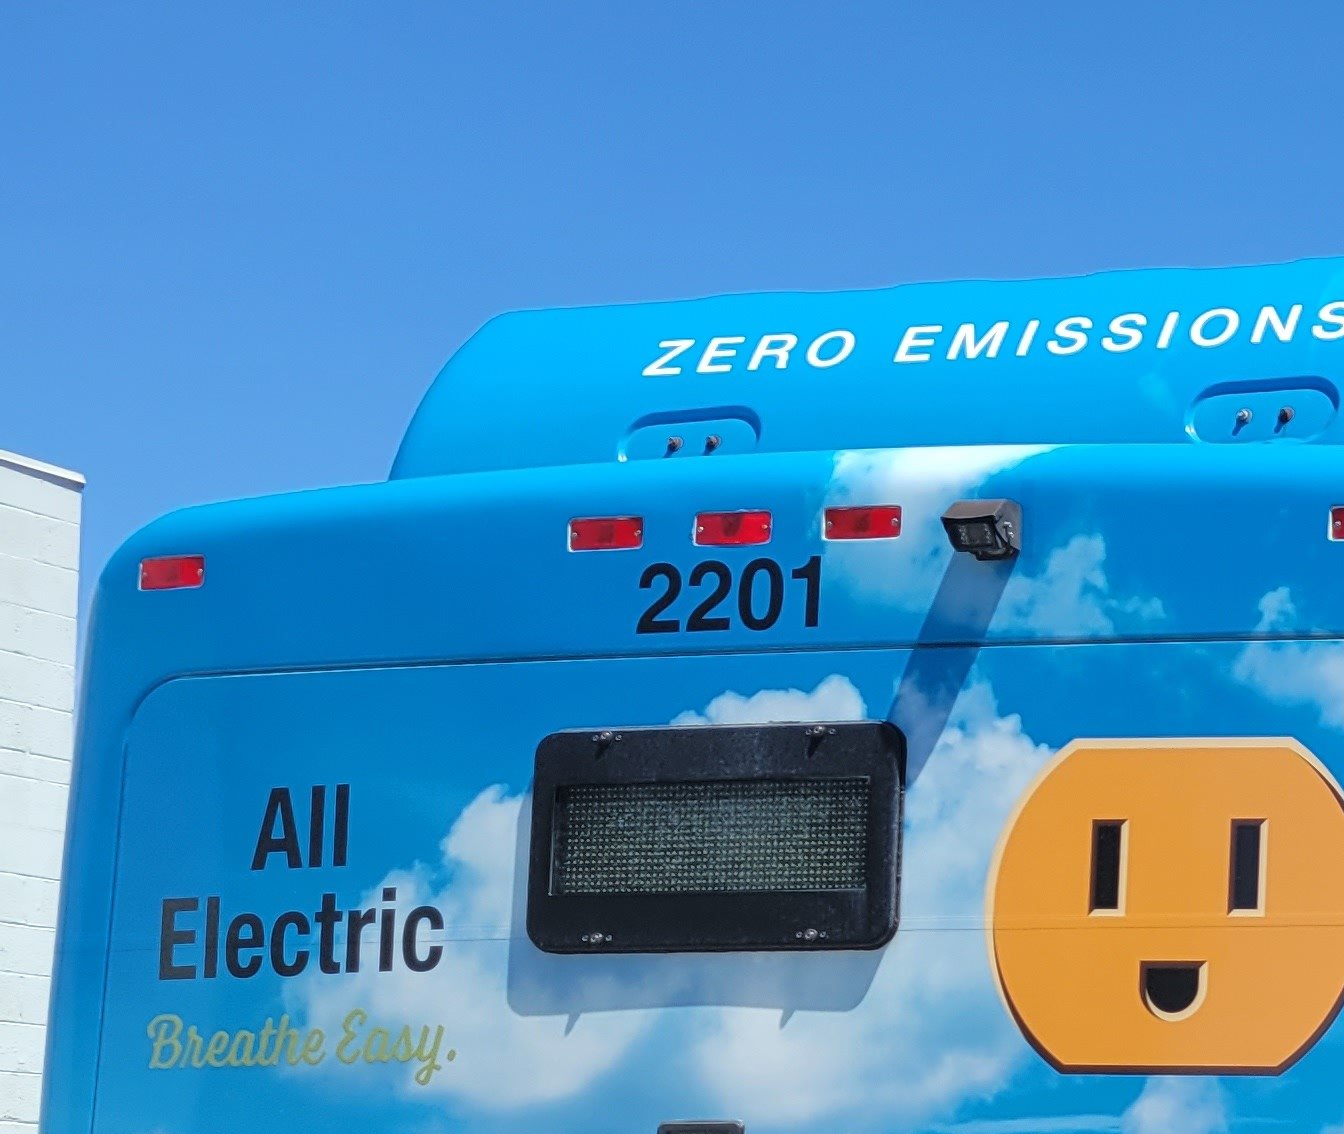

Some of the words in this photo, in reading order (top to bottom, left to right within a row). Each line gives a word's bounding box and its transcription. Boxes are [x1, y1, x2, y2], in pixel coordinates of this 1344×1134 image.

[643, 330, 856, 377] ZERO
[636, 555, 822, 635] 2201
[251, 783, 350, 871] All
[158, 886, 445, 981] Electric
[147, 1013, 326, 1070] Breathe
[336, 1008, 457, 1086] Easy.
